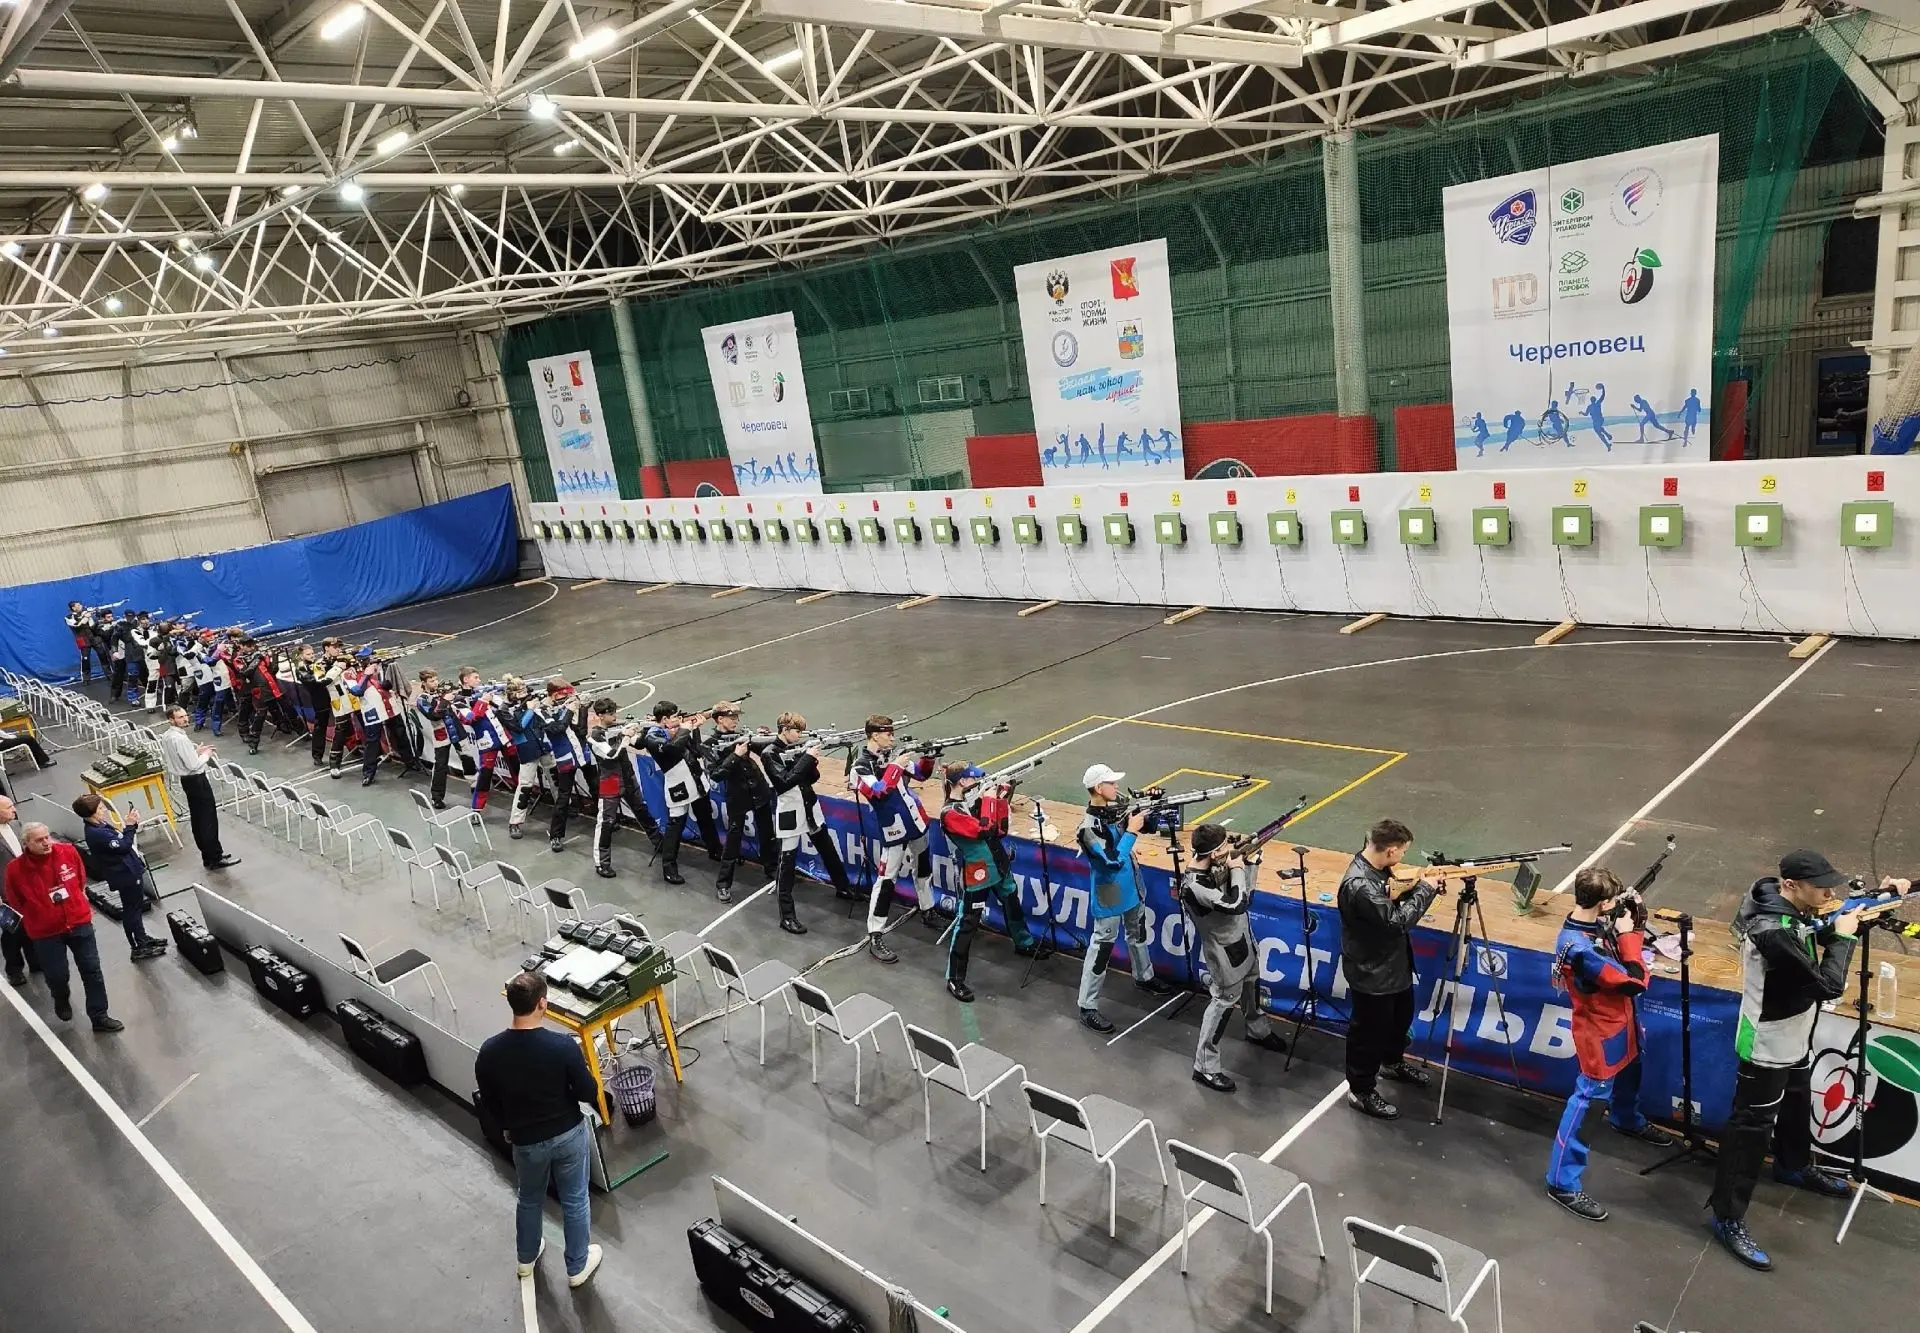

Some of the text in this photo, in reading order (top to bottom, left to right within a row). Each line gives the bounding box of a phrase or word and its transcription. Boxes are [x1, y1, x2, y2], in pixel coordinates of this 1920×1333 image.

[1556, 222, 1590, 232] УПАКОВКА
[1558, 277, 1590, 286] ПЛАНЕТА
[1558, 283, 1590, 292] КОРОБОК
[1080, 308, 1107, 318] НОРМА
[1082, 317, 1108, 327] ЖИЗНИ
[1509, 335, 1645, 364] Череповец
[740, 420, 788, 433] Череповец
[1762, 479, 1776, 489] 29
[1868, 475, 1884, 486] 30
[1494, 485, 1505, 495] 26
[1574, 482, 1586, 493] 27
[1664, 482, 1677, 491] 28
[1286, 491, 1296, 499] 23
[1349, 488, 1359, 498] 24
[1420, 487, 1431, 497] 25
[1172, 494, 1180, 502] 21
[653, 961, 672, 978] SIUS
